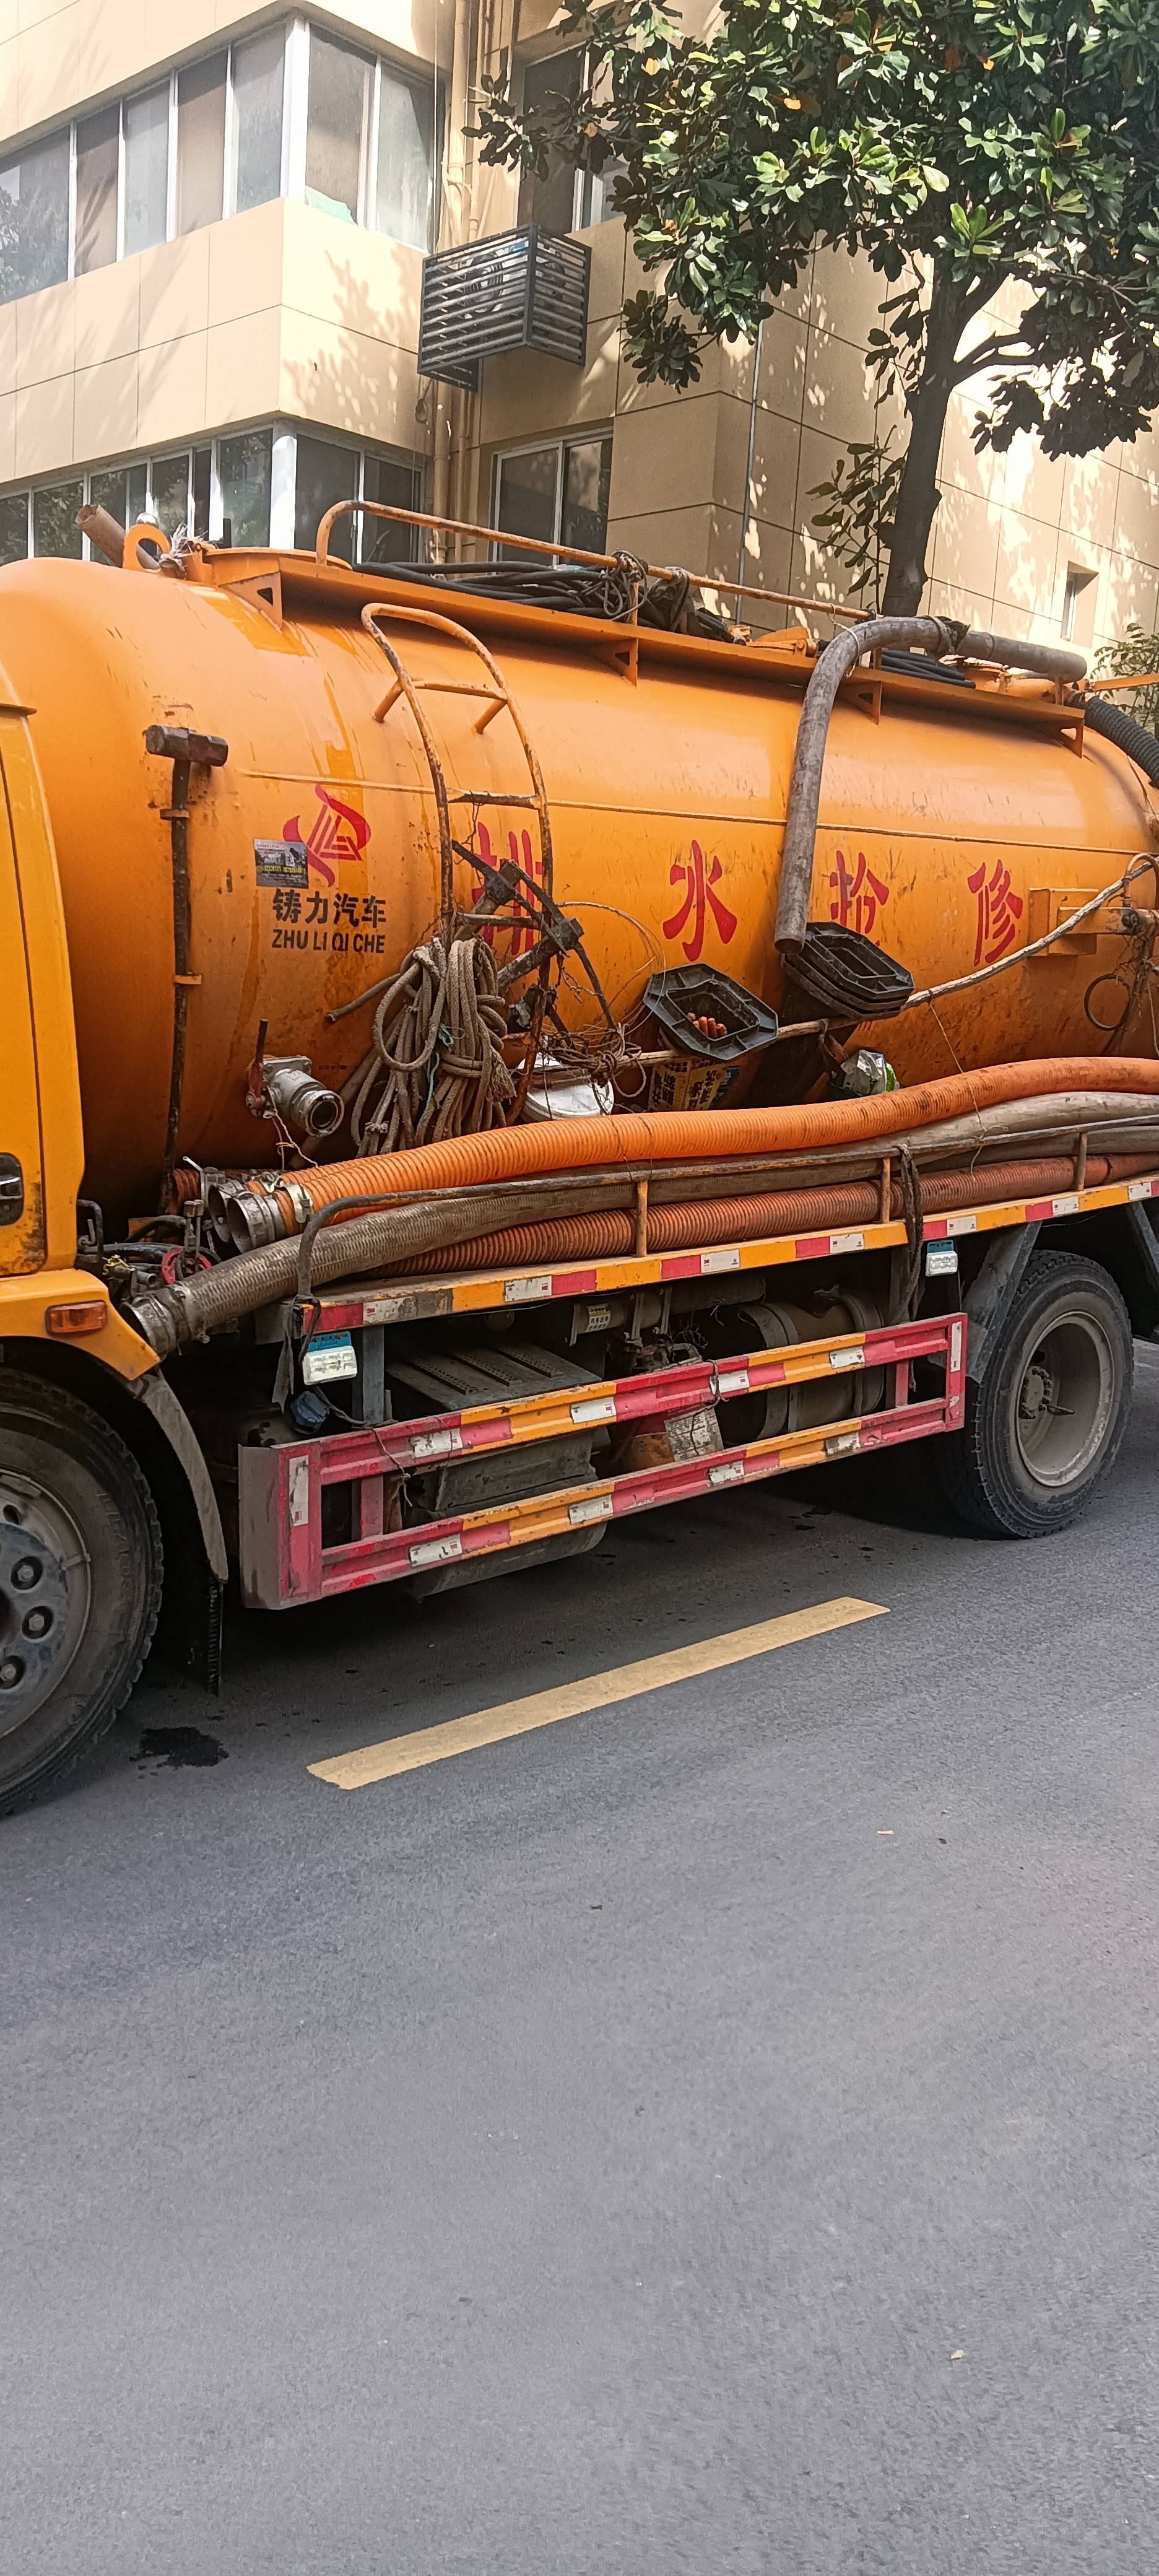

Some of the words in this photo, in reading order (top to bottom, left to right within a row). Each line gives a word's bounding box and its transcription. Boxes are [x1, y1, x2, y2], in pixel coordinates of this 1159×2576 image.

[272, 889, 386, 928] 铸力汽车
[271, 929, 308, 949] ZHU
[313, 931, 328, 951] LI
[331, 932, 349, 952] QI
[353, 933, 386, 954] CHE
